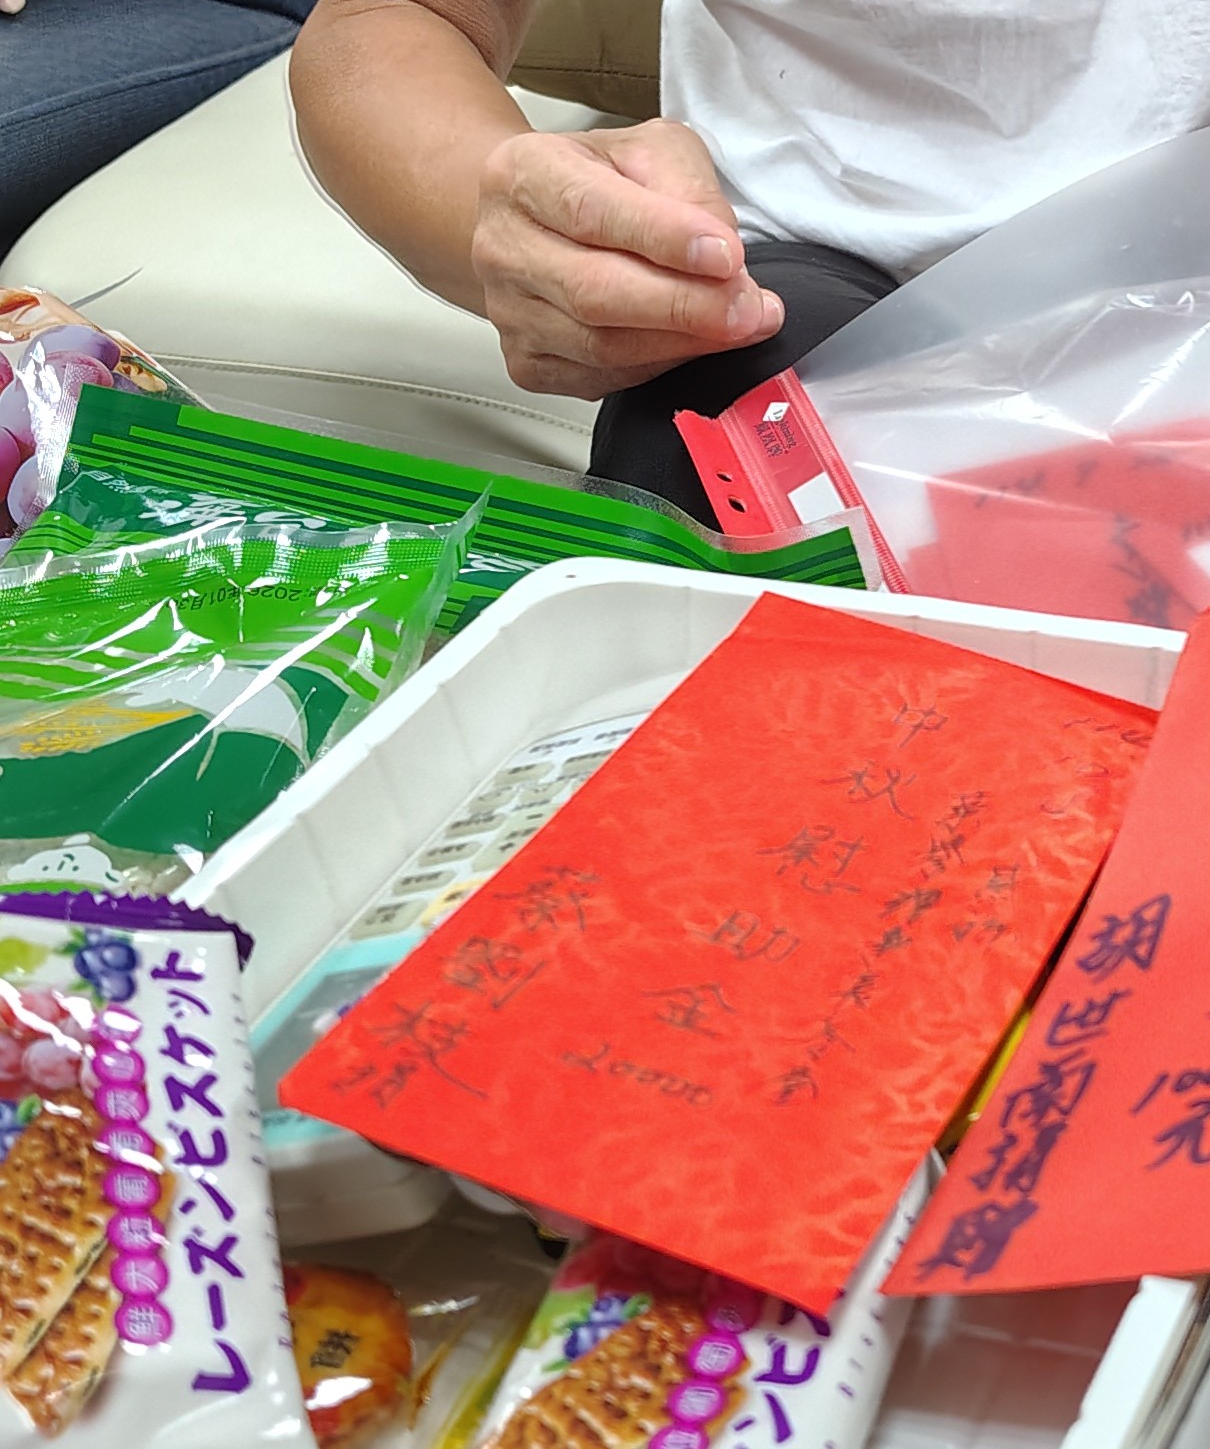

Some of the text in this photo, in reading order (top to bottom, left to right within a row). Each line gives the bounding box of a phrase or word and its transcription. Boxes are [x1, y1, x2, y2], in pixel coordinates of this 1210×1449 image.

[150, 951, 253, 1394] レーズンビスケット
